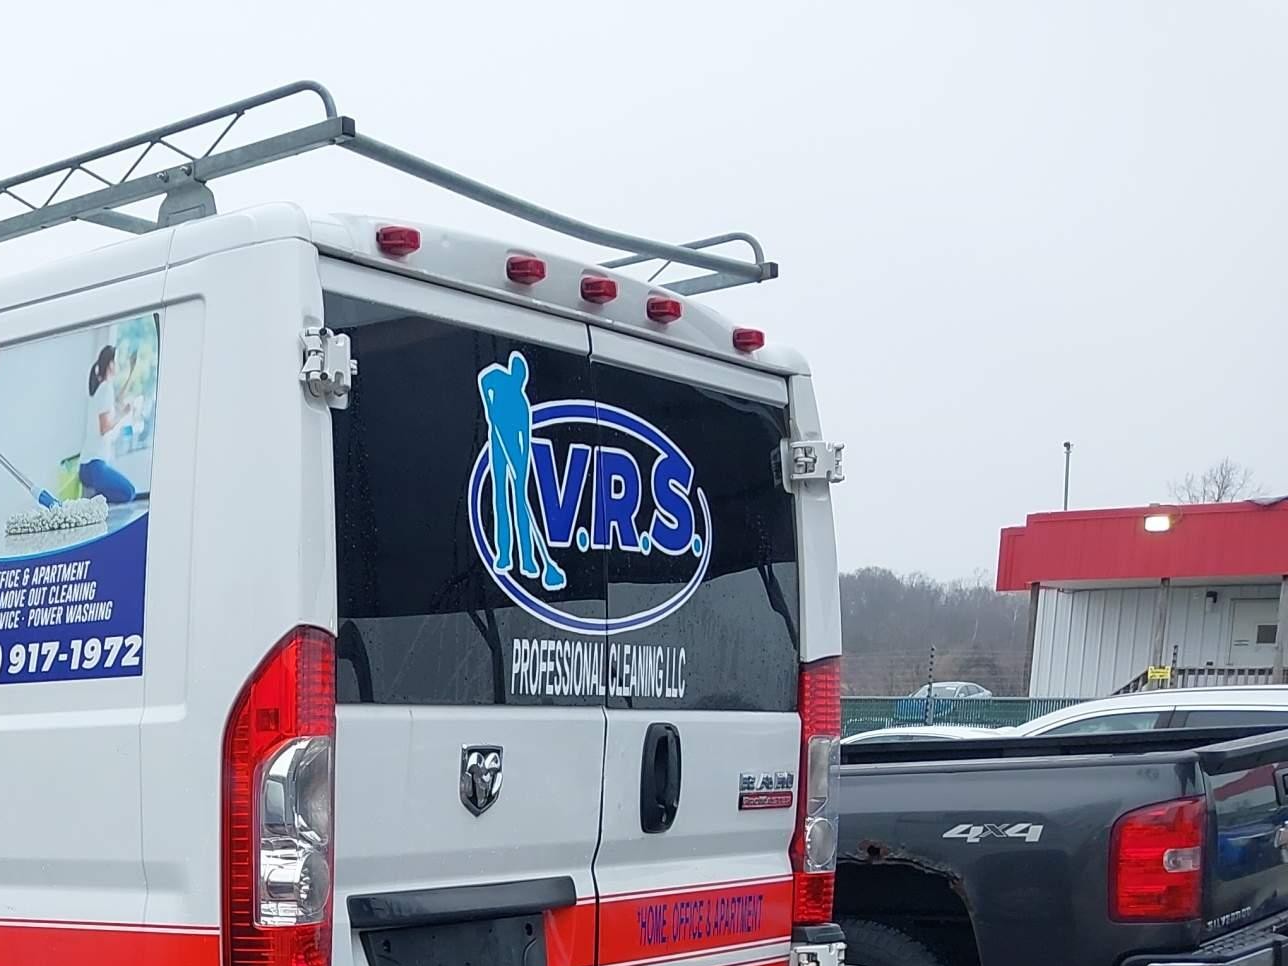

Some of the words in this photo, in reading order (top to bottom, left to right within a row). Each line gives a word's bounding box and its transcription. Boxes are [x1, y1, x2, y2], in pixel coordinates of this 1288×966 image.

[531, 438, 702, 558] V.R.S.
[22, 567, 30, 587] &
[31, 560, 91, 586] APARTMENT
[27, 586, 47, 607] OUT
[48, 581, 98, 605] CLEANING
[27, 606, 64, 628] POWER
[65, 600, 113, 625] WASHING
[7, 634, 143, 676] 917-1972
[511, 638, 606, 697] PROFESSIONAL
[608, 642, 664, 699] CLEANING
[665, 646, 687, 699] LLC
[672, 900, 704, 944] OFFICE
[712, 894, 764, 938] APARTMENT
